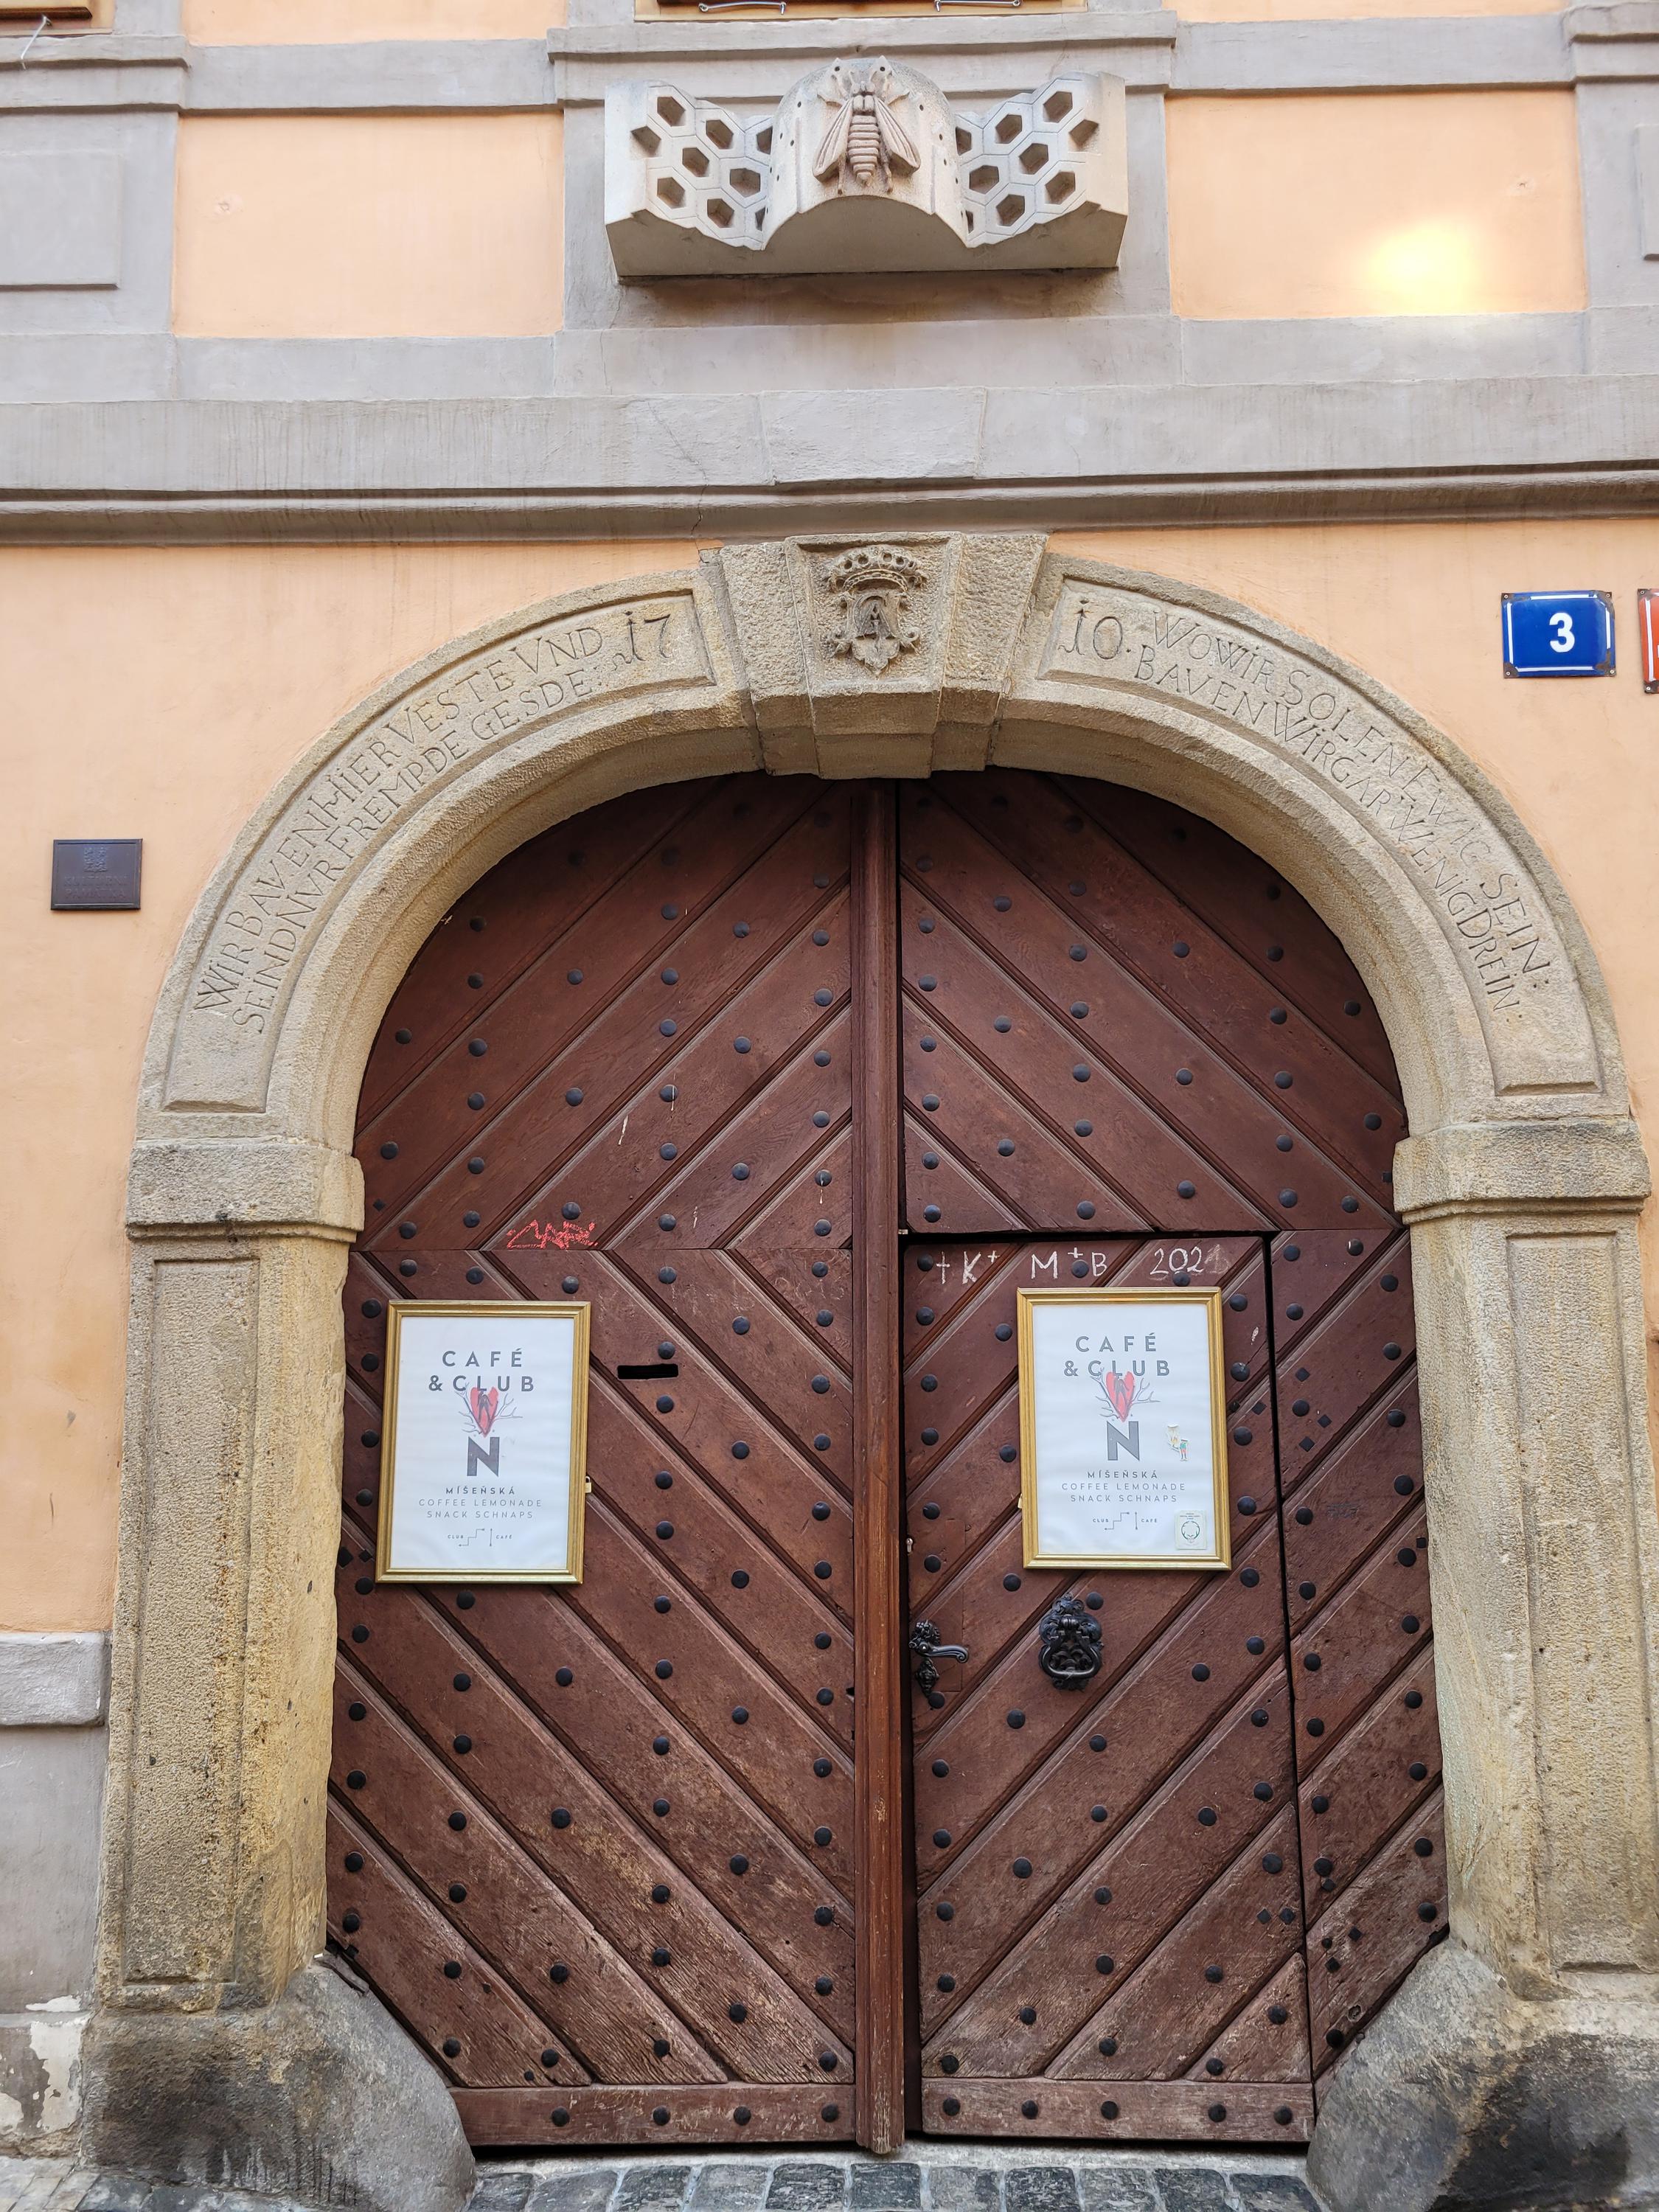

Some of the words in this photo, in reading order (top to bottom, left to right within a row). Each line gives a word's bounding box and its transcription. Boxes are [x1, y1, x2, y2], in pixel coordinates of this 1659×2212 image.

[1549, 612, 1575, 653] 3
[382, 659, 514, 745] VESTE
[507, 627, 602, 674] VND
[1075, 1332, 1157, 1352] CAFÉ
[442, 1348, 523, 1367] CAFÉ
[1106, 1421, 1140, 1461] N
[467, 1436, 501, 1477] N
[1088, 1470, 1158, 1479] MÍŠEŇSKÁ
[445, 1486, 515, 1495] MÍŠEŇSKÁ
[1062, 1483, 1109, 1491] COFFEE
[1116, 1483, 1186, 1491] LEMONADE
[474, 1499, 543, 1507] LEMONADE
[475, 1511, 534, 1519] SCHNAPS
